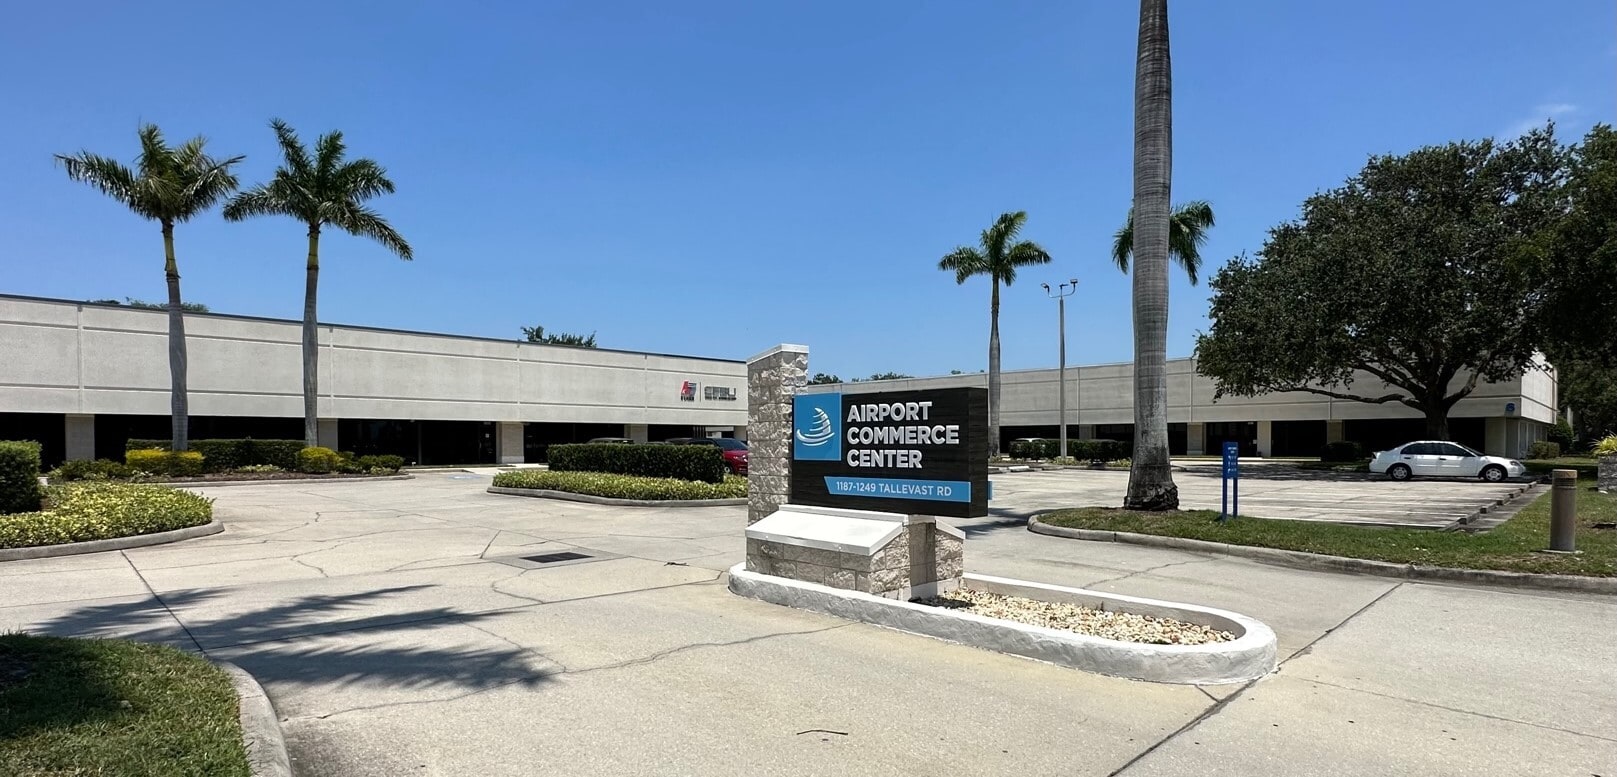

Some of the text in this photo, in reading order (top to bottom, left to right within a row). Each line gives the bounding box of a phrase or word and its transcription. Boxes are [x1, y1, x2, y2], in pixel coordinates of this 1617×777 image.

[847, 402, 932, 422] AIRPORT
[847, 425, 959, 444] COMMERCE
[847, 449, 922, 468] CENTER
[836, 481, 952, 496] 1187-1249 TALLEVAST RD
